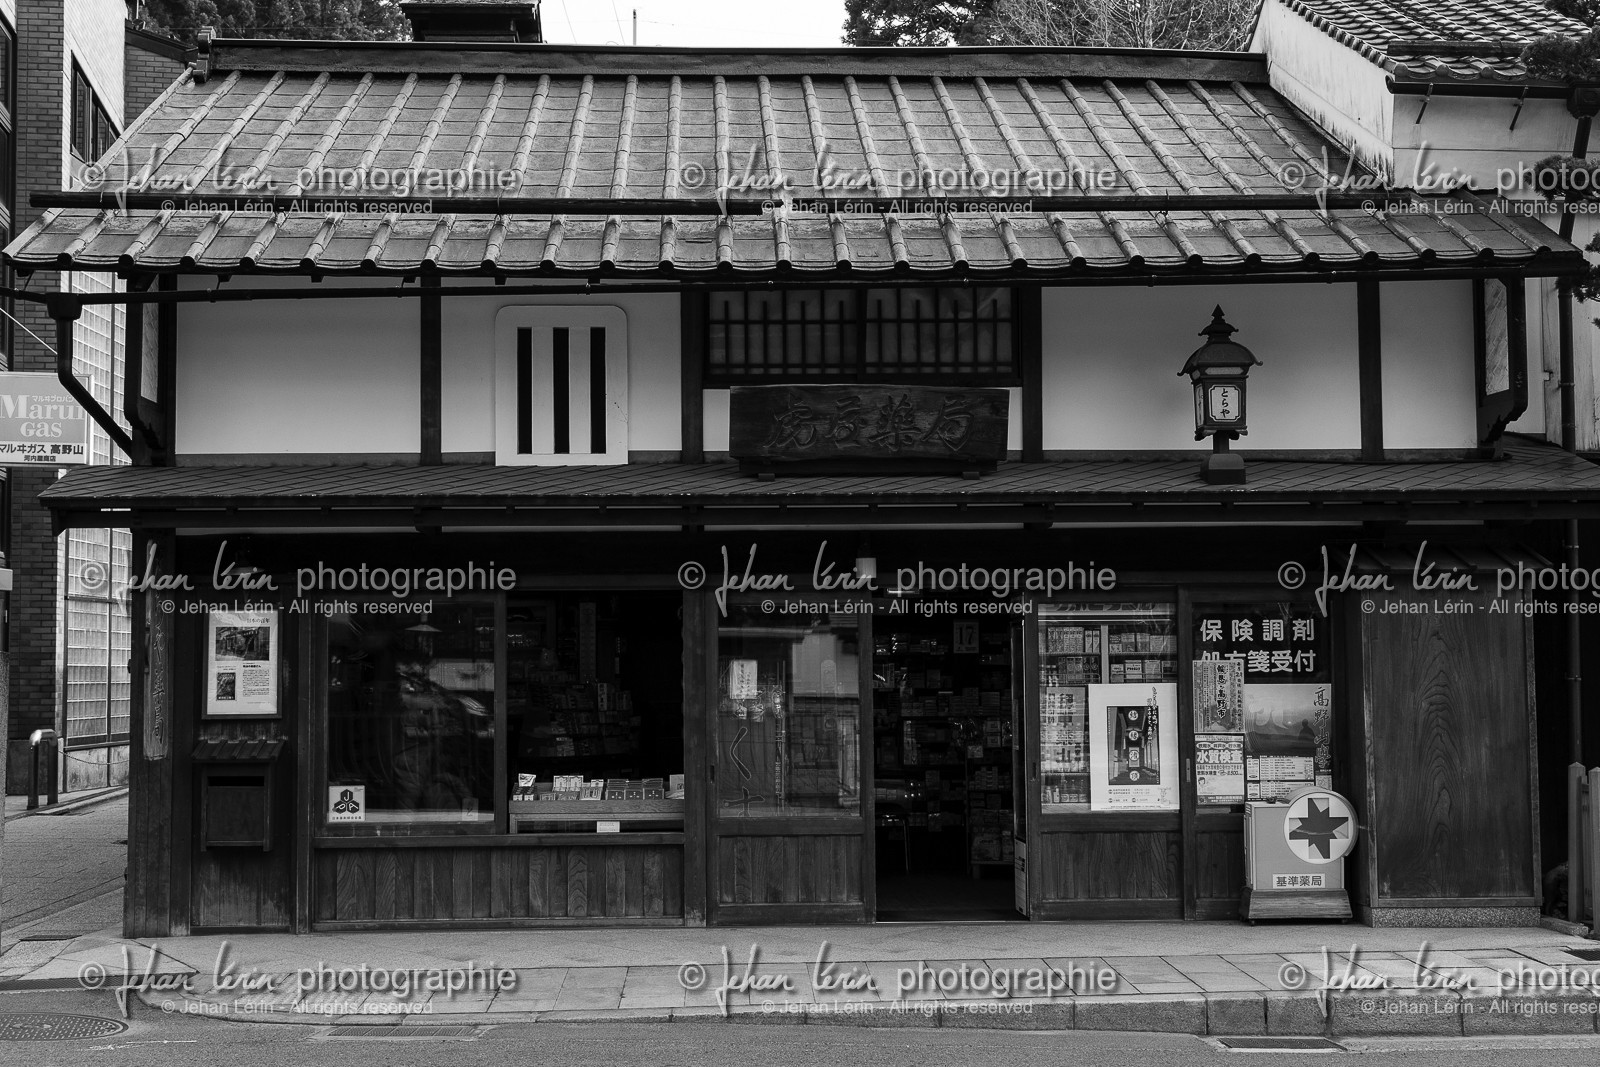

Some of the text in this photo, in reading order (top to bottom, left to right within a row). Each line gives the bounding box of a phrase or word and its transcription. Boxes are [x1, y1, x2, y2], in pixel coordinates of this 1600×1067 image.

[1220, 387, 1230, 418] とらや
[20, 421, 62, 437] Gas
[50, 444, 84, 455] 高野山
[1200, 619, 1314, 641] 保険調剤
[1196, 749, 1243, 763] 水質検査
